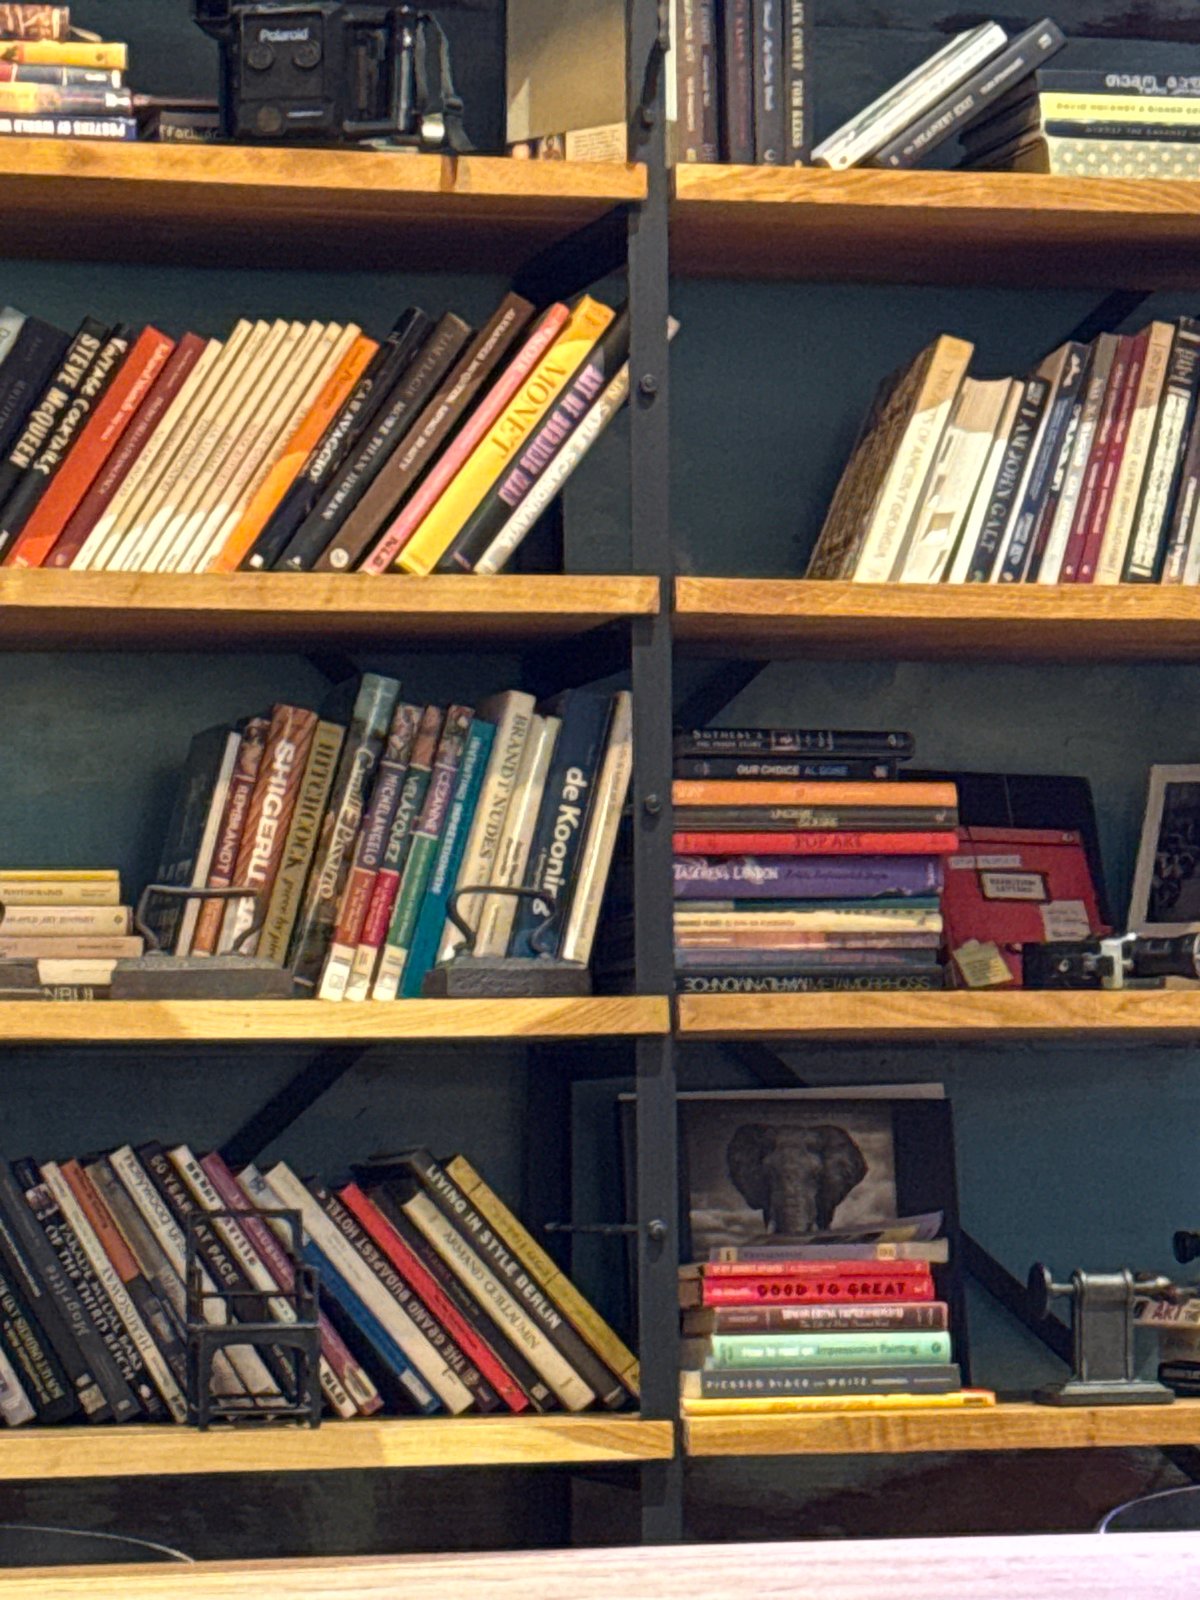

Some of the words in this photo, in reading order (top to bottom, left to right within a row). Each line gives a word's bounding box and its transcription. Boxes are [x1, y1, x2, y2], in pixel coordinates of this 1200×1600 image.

[259, 27, 310, 43] Polaroid
[791, 80, 804, 107] TOM
[57, 333, 101, 390] STEVE
[79, 337, 128, 395] VINTAGE
[9, 386, 69, 469] McQUEEN
[308, 378, 373, 483] CARAVAGGIO
[493, 361, 567, 460] MONET
[1010, 419, 1034, 450] AM
[354, 434, 384, 476] THAN
[892, 445, 925, 503] ANCIENT
[994, 449, 1025, 501] JOHN
[322, 470, 359, 519] HUMAN
[502, 445, 578, 552] SCANDINAVIA
[871, 502, 904, 561] GEORGIA
[977, 500, 1008, 554] GALT
[497, 712, 529, 793] BRANDT
[736, 764, 760, 776] OUR
[247, 739, 295, 882] SHIGERU
[284, 741, 333, 869] HITCHCOCK
[562, 766, 588, 801] de
[217, 784, 248, 874] REMBRANDT
[363, 773, 398, 865] MICHELANGELO
[479, 794, 509, 862] NUDES
[831, 834, 862, 848] ART
[322, 1195, 361, 1238] HOTEL
[45, 1223, 64, 1250] OF
[57, 1247, 82, 1281] THE
[75, 1279, 109, 1329] THIRD
[193, 1221, 215, 1245] AT
[206, 1242, 241, 1287] PACE
[354, 1235, 412, 1302] BUDAPEST
[423, 1163, 470, 1216] LIVING
[462, 1210, 484, 1233] IN
[477, 1229, 520, 1277] STYLE
[512, 1272, 564, 1331] BERLIN
[442, 1227, 487, 1283] ARMAND
[46, 1266, 90, 1336] Magritte
[102, 1266, 156, 1352] HEMINGWAY
[757, 1283, 807, 1297] GOOD
[816, 1283, 840, 1296] TO
[847, 1282, 905, 1296] GREAT
[405, 1298, 448, 1346] GRAND
[441, 1342, 467, 1370] THE
